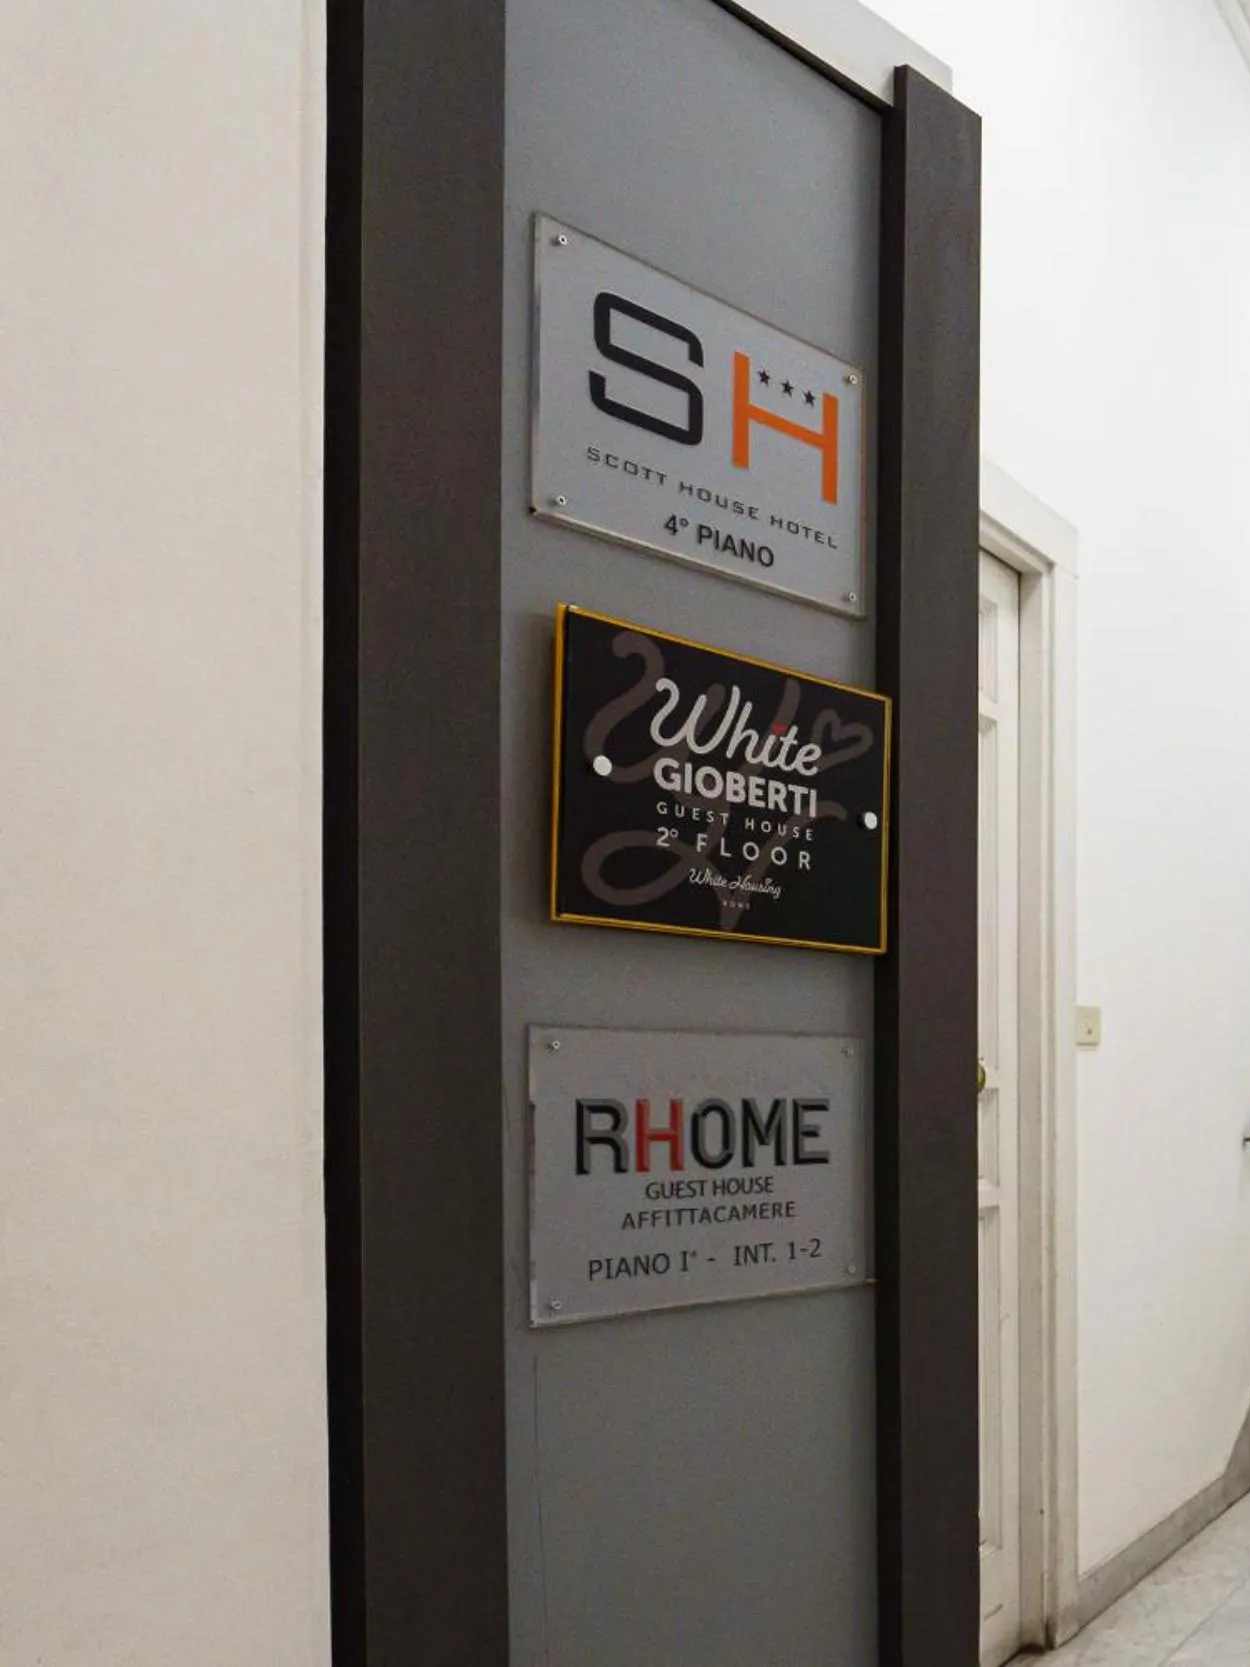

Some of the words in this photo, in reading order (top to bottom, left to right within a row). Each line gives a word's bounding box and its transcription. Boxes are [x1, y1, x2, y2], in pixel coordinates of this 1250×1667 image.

[587, 446, 667, 486] SCOTT
[679, 481, 760, 520] HOUSE
[770, 515, 838, 549] HOTEL
[696, 524, 774, 567] PIANO
[650, 678, 822, 776] White
[653, 757, 818, 818] GIOBERTI
[656, 801, 729, 824] GUEST
[745, 818, 813, 841] HOUSE
[696, 833, 811, 871] FLOOR
[689, 867, 727, 888] White
[728, 874, 781, 899] Housing
[575, 1097, 829, 1175] RHOME
[645, 1180, 707, 1201] GUEST
[712, 1176, 774, 1196] HOUSE
[621, 1201, 797, 1230] AFFITTACAMERE
[588, 1253, 670, 1281] PIANO
[734, 1242, 776, 1266] INT.
[788, 1238, 822, 1260] 1-2
